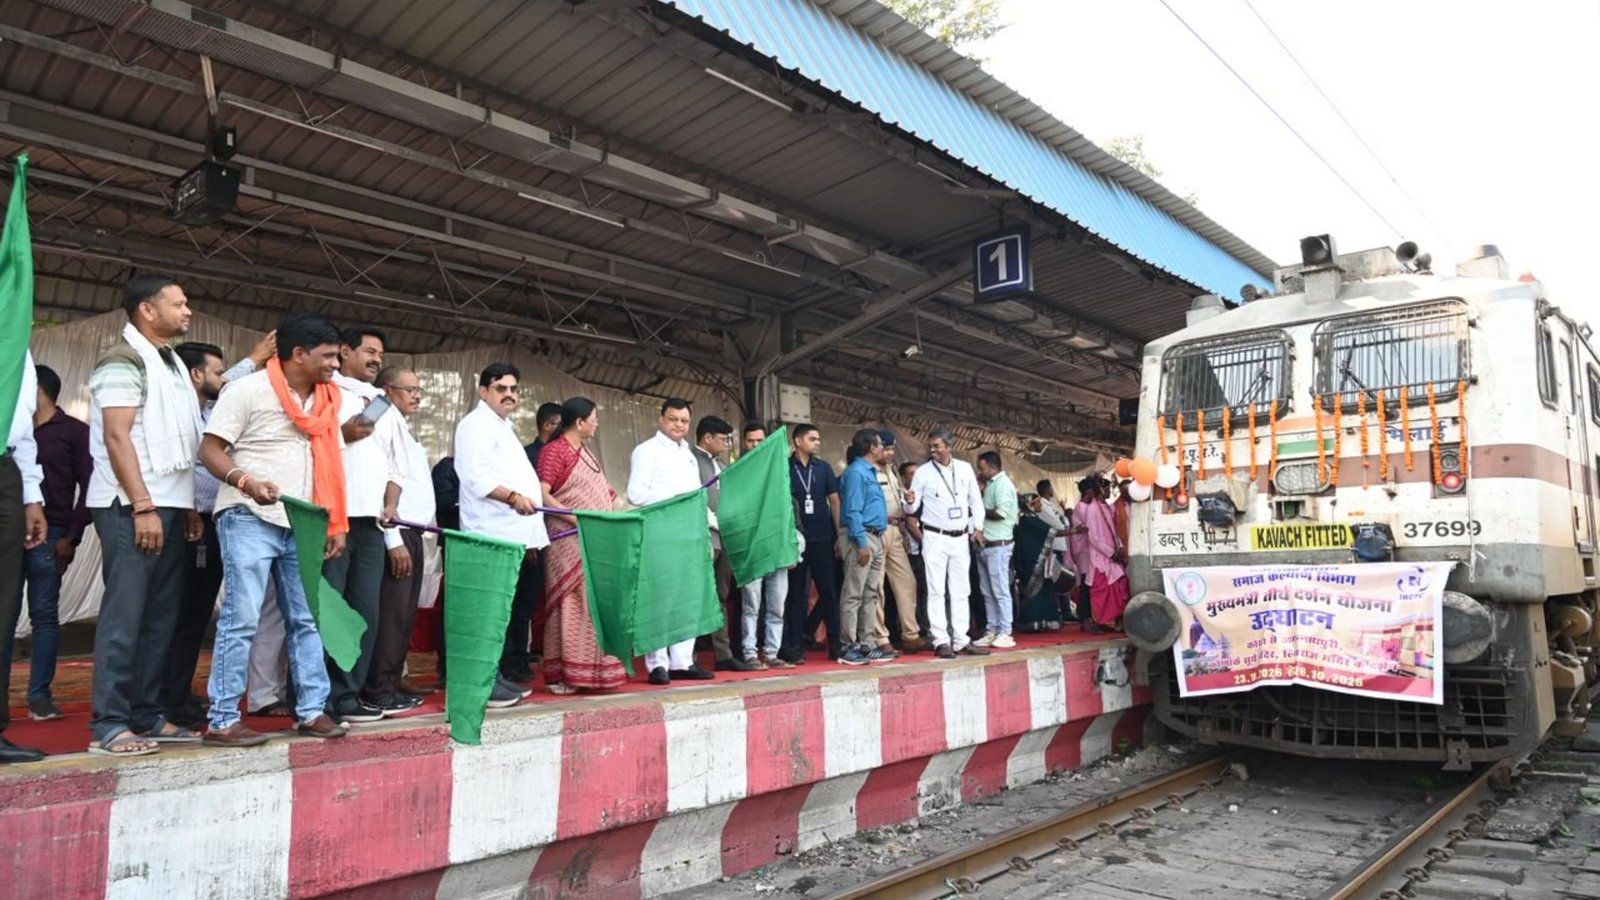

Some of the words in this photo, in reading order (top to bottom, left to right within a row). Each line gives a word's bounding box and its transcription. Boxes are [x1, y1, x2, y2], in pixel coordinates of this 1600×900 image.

[989, 242, 1008, 282] 1
[1256, 525, 1302, 549] KAVACH
[1305, 523, 1348, 548] FITTED
[1403, 519, 1483, 539] 37699
[1232, 573, 1264, 589] समाज
[1206, 590, 1260, 617] मुख्यमंत्री
[1293, 586, 1332, 606] दर्शन
[1336, 592, 1393, 613] योजना
